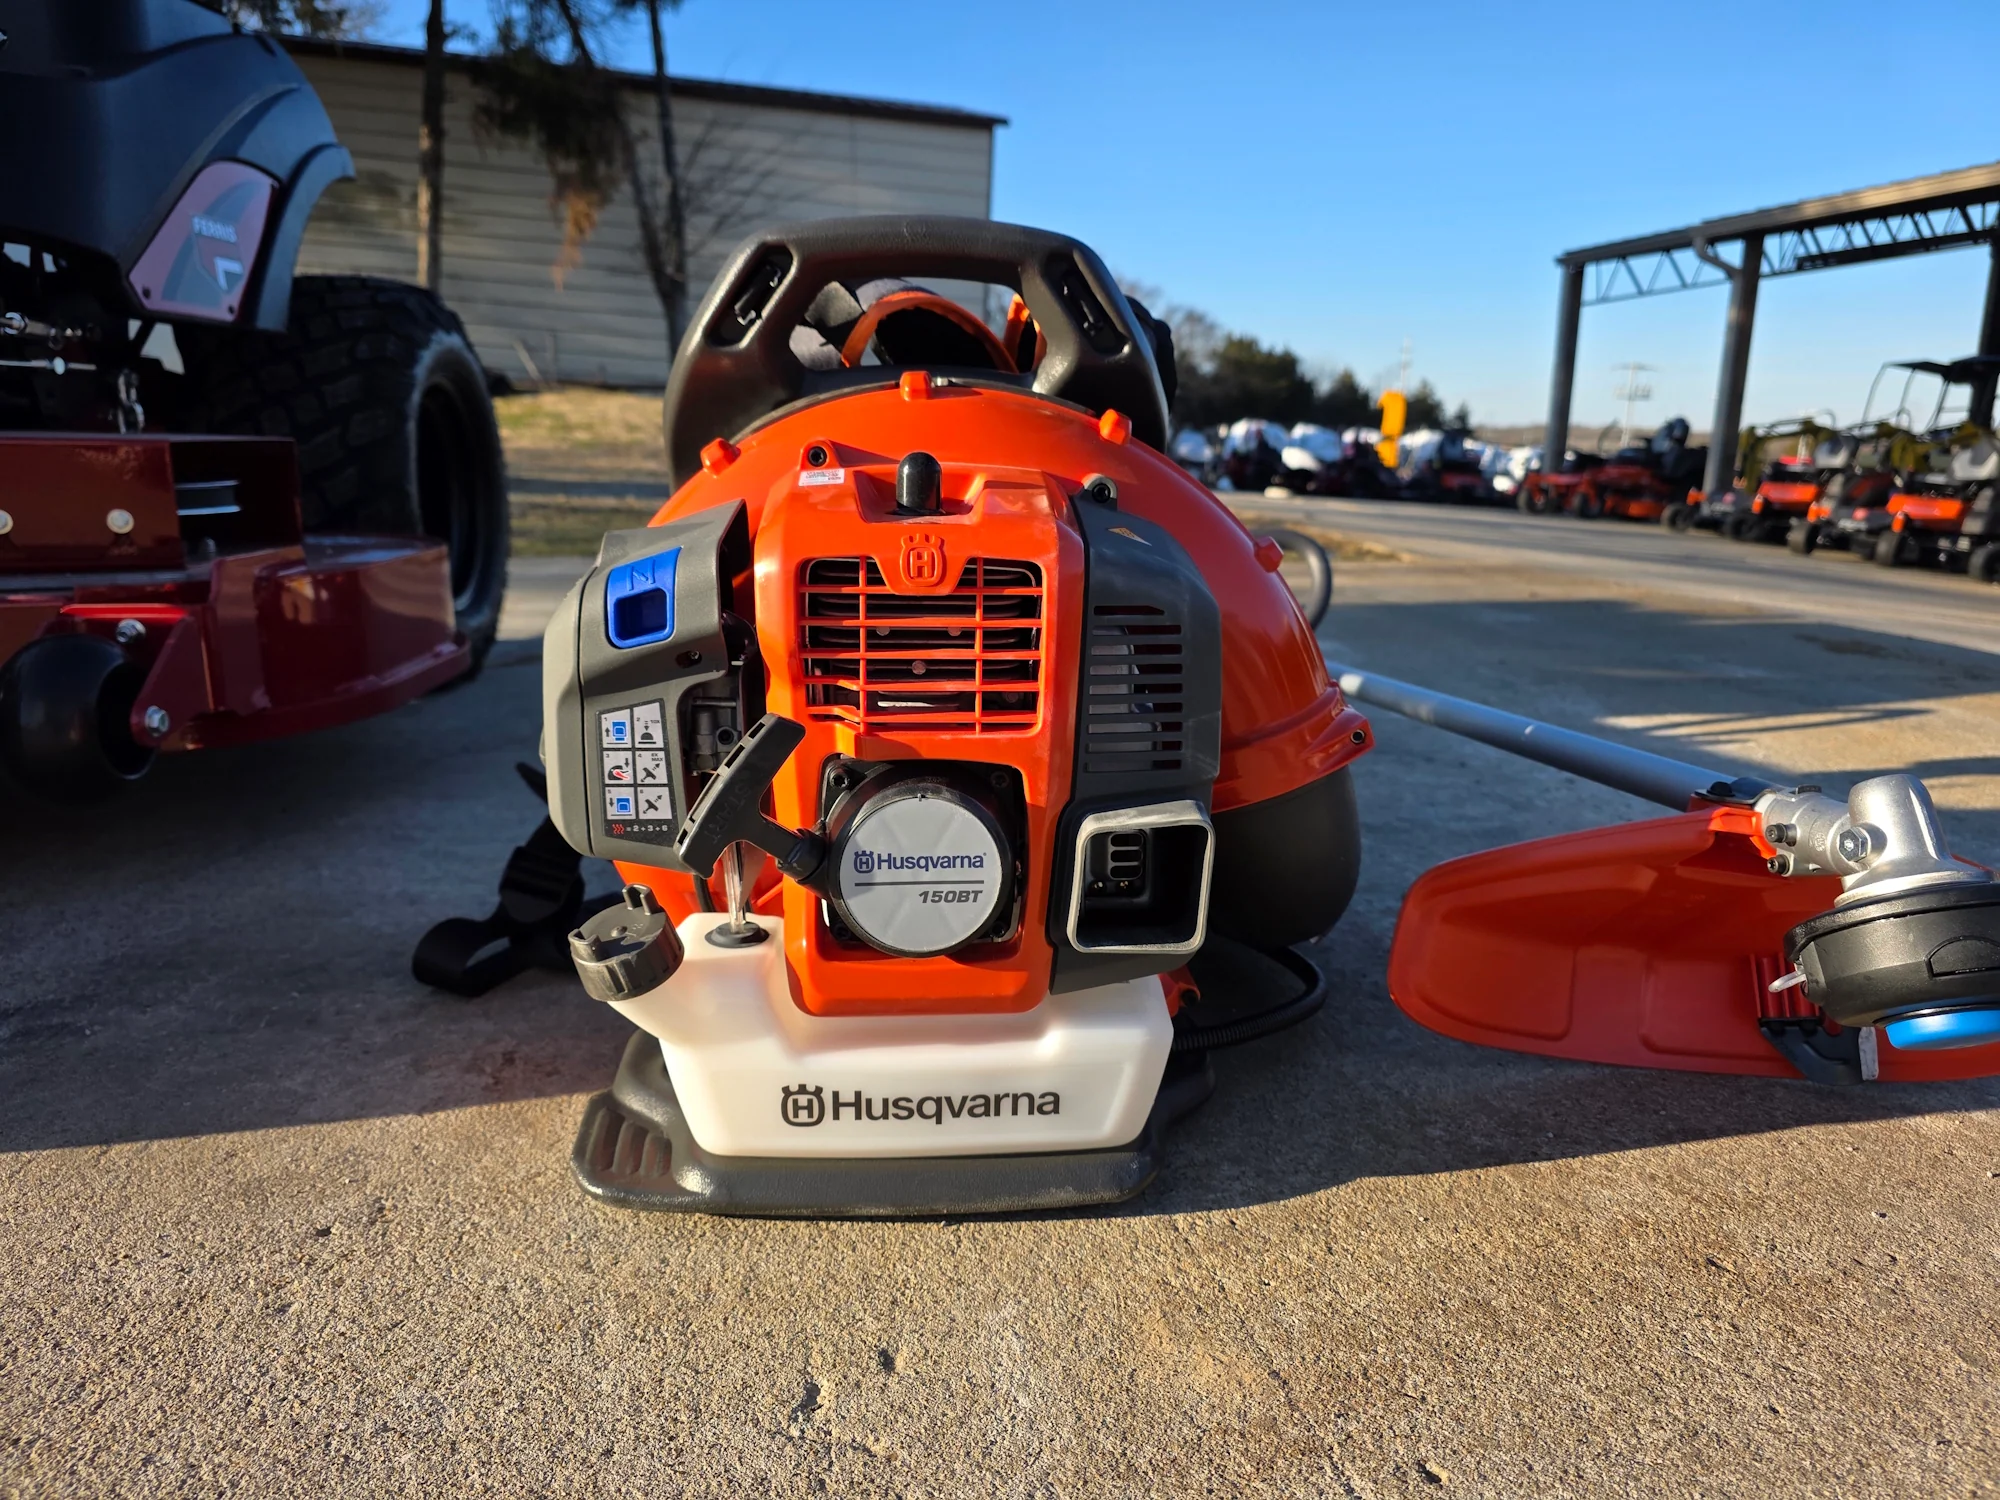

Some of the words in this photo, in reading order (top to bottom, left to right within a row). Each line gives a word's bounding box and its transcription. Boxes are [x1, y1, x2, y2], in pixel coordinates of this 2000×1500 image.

[877, 852, 984, 872] Husqvarna
[918, 890, 983, 903] 150BT
[832, 1090, 1060, 1125] Husqvarna
